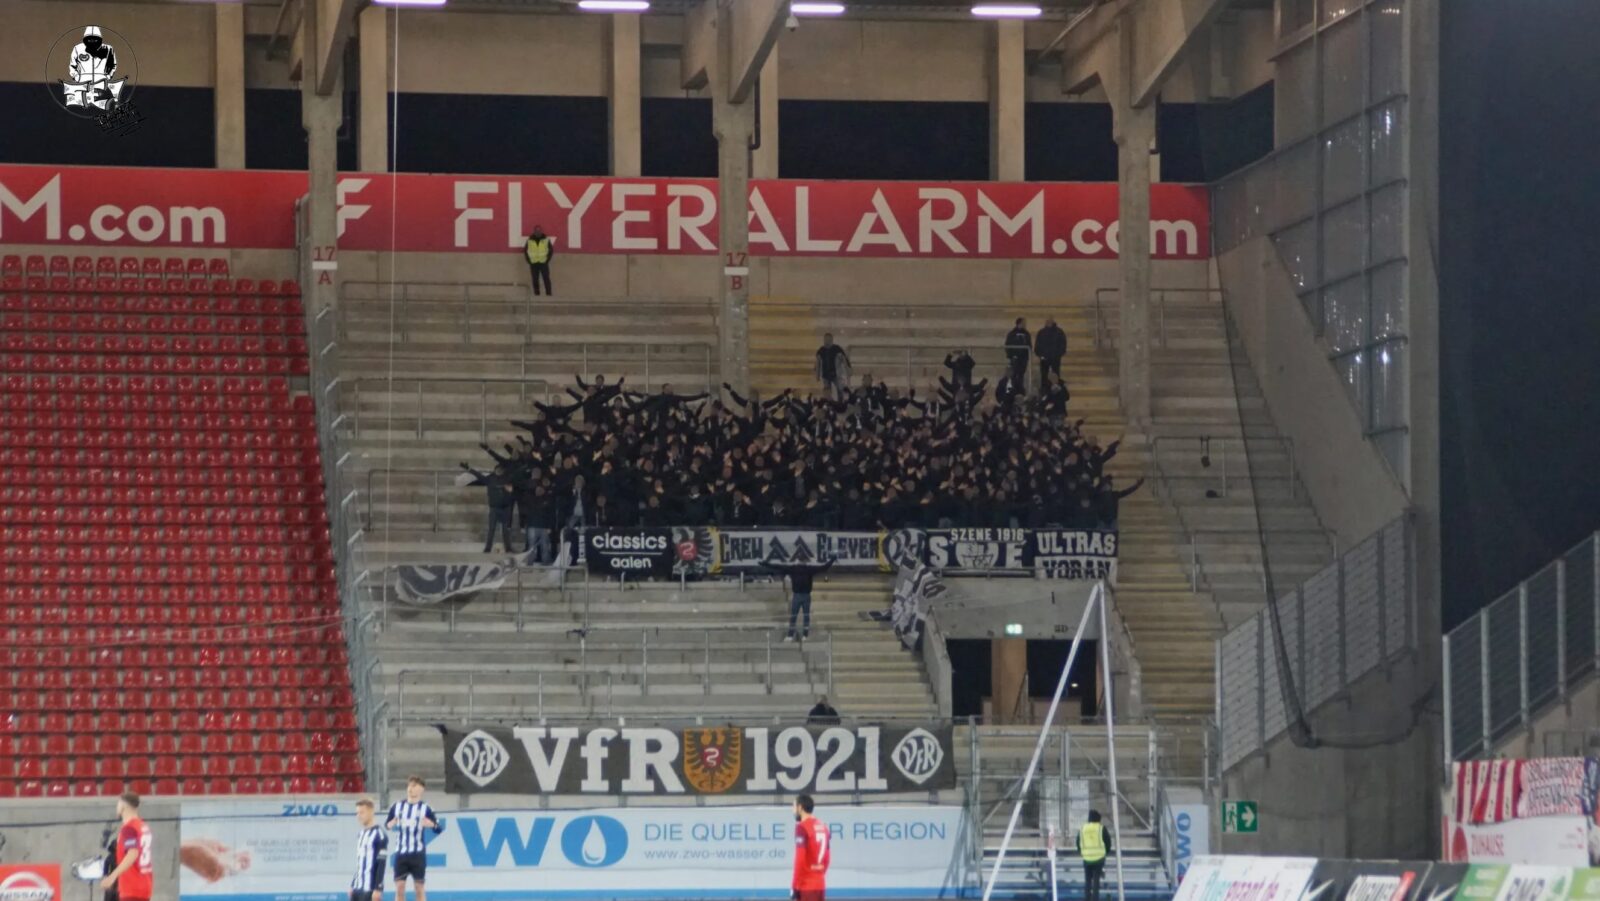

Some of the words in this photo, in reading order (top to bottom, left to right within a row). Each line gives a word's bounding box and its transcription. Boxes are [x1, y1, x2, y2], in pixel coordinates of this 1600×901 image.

[313, 246, 336, 261] 17
[726, 252, 747, 267] 17
[318, 270, 332, 285] A
[731, 275, 743, 290] B
[592, 532, 667, 549] classics
[951, 528, 992, 541] SZENE
[1036, 532, 1116, 555] ULTRAS
[610, 556, 652, 569] aalen
[513, 727, 685, 792] VfR
[746, 727, 888, 792] 1921
[281, 804, 338, 817] ZWO
[644, 823, 682, 841] DIE
[692, 822, 785, 842] QUELLE
[853, 822, 946, 841] REGION
[645, 848, 786, 860] www.zwo-wasser.de
[815, 832, 826, 864] 7
